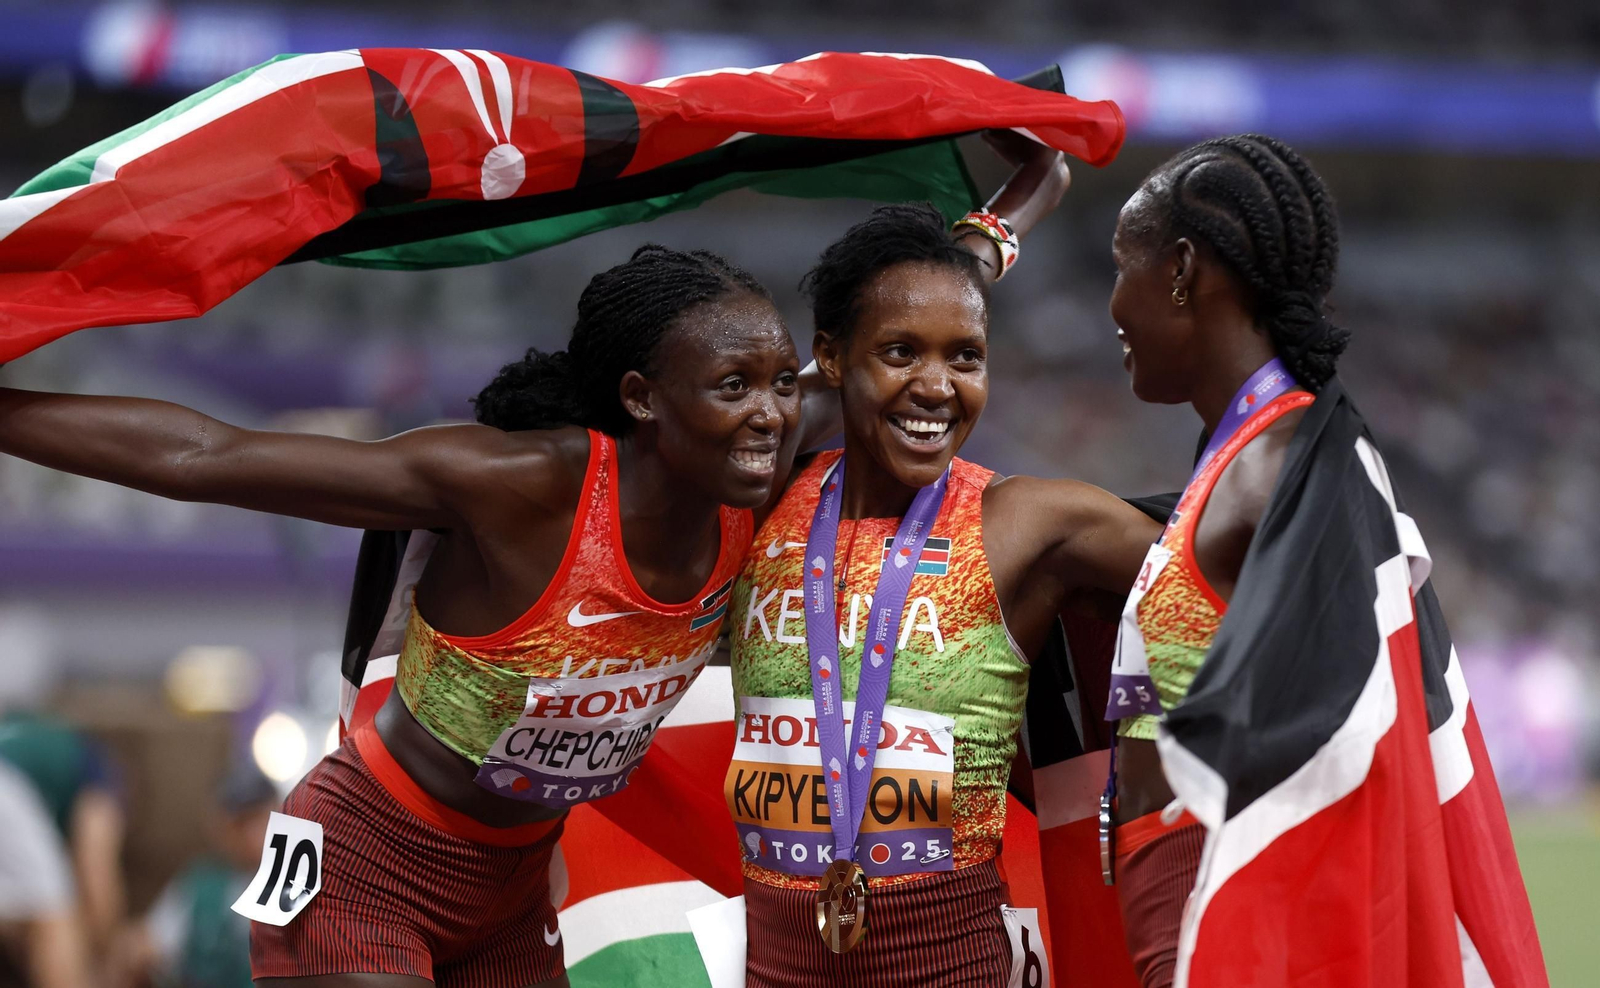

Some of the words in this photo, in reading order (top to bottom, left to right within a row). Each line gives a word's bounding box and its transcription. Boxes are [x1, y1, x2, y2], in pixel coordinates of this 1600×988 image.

[744, 586, 945, 652] KEA
[734, 769, 938, 825] KIPYEON
[256, 834, 318, 912] 10
[1021, 925, 1043, 988] 6
